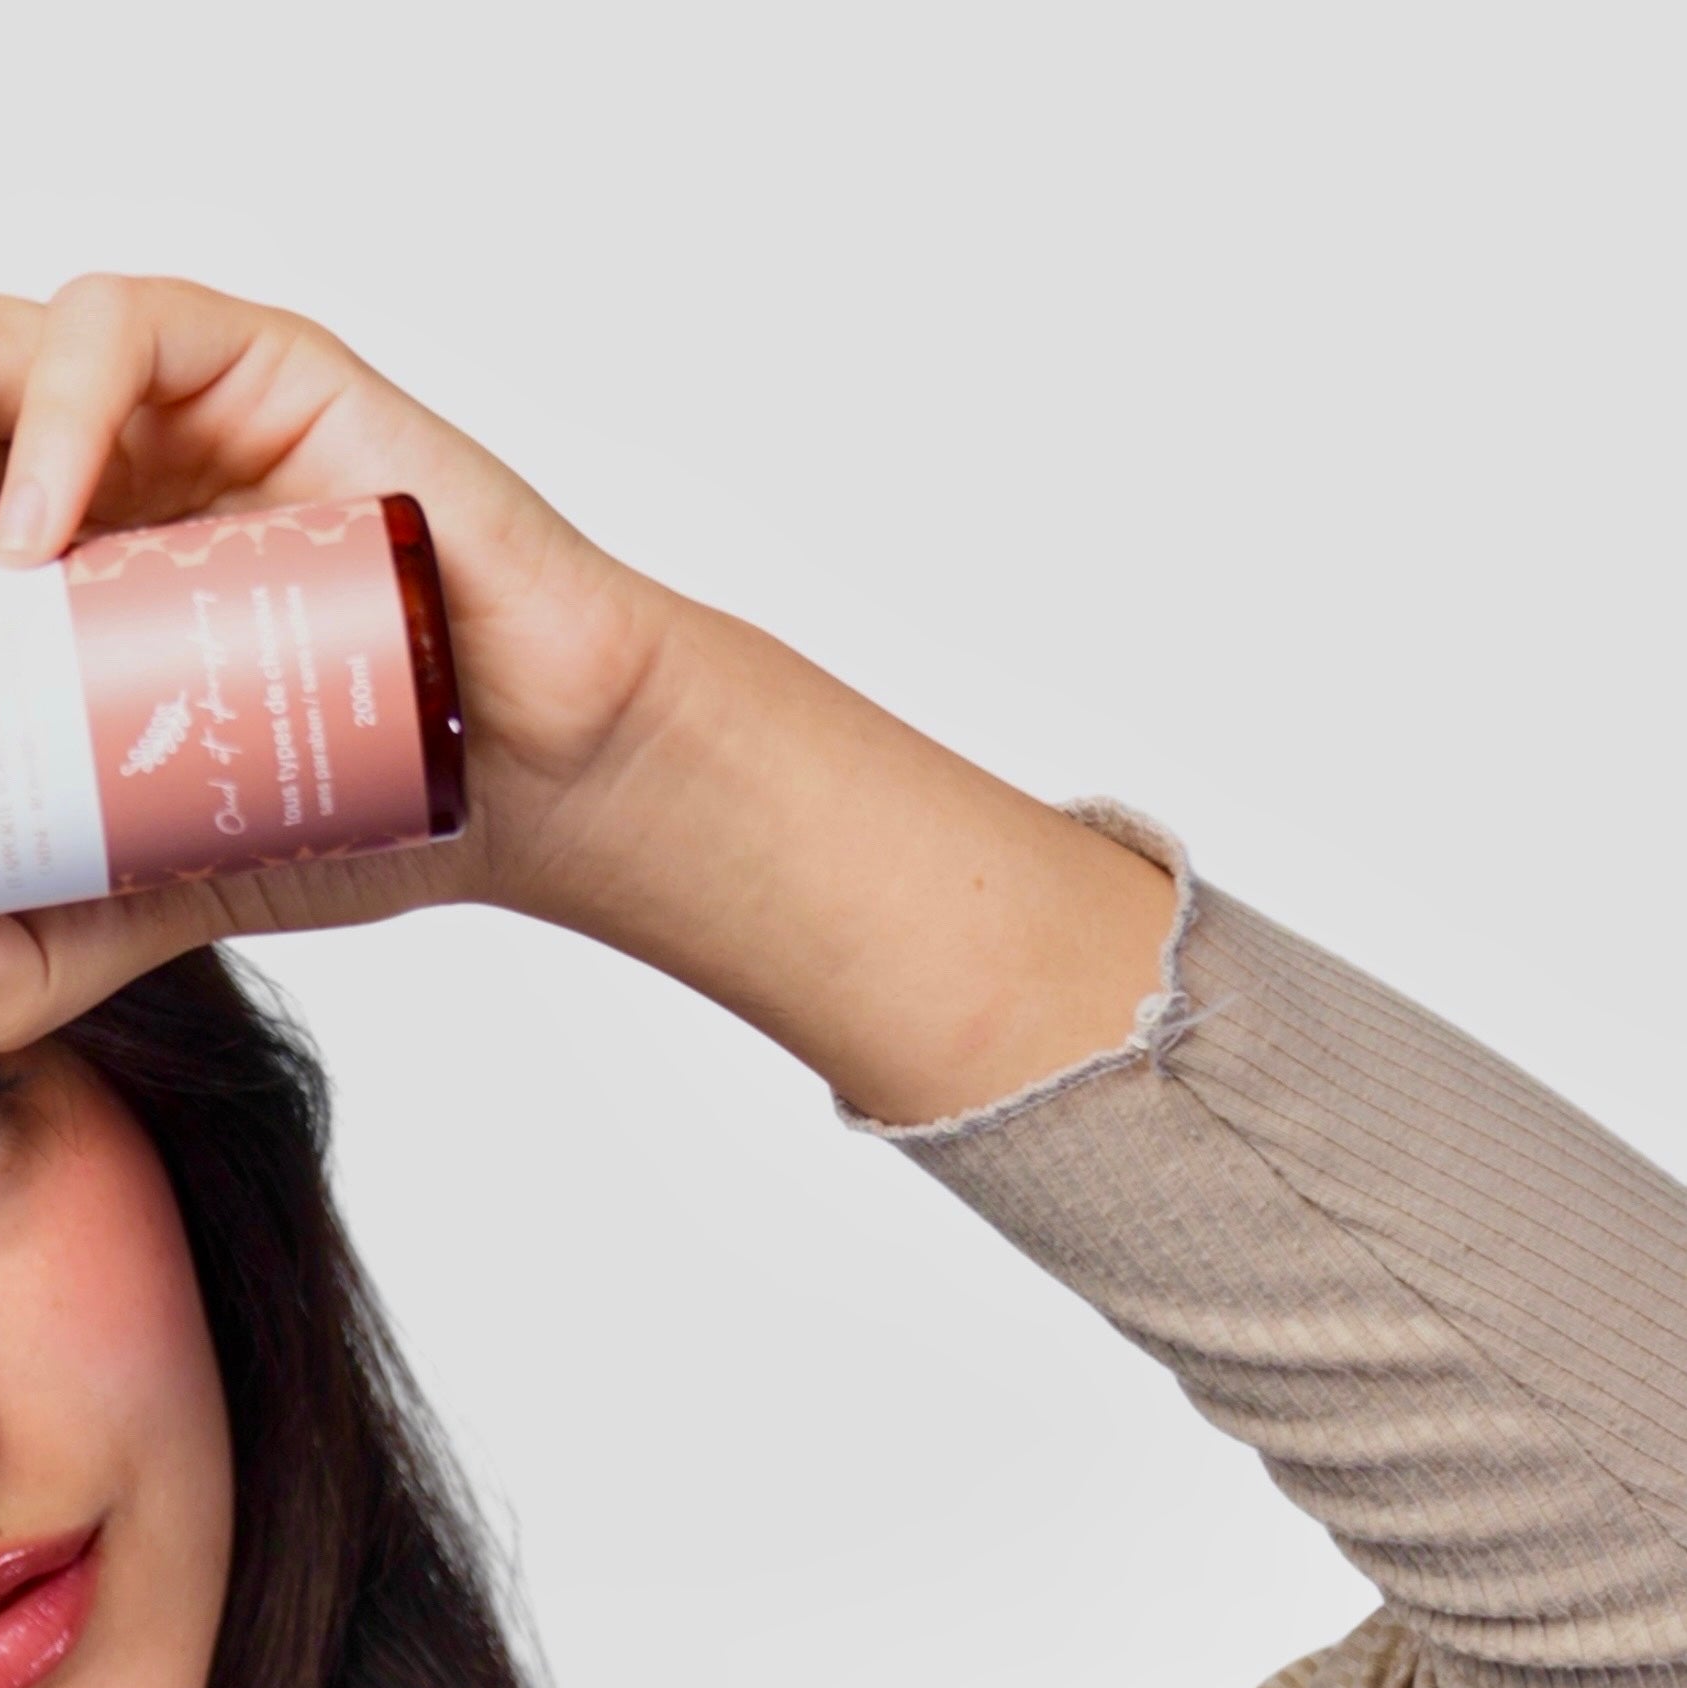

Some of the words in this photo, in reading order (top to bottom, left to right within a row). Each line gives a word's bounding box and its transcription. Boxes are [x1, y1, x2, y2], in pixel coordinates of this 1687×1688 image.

[264, 684, 288, 715] de
[346, 654, 378, 728] 200ml
[272, 717, 298, 782] types
[307, 707, 332, 780] paraben
[282, 784, 302, 826] tous
